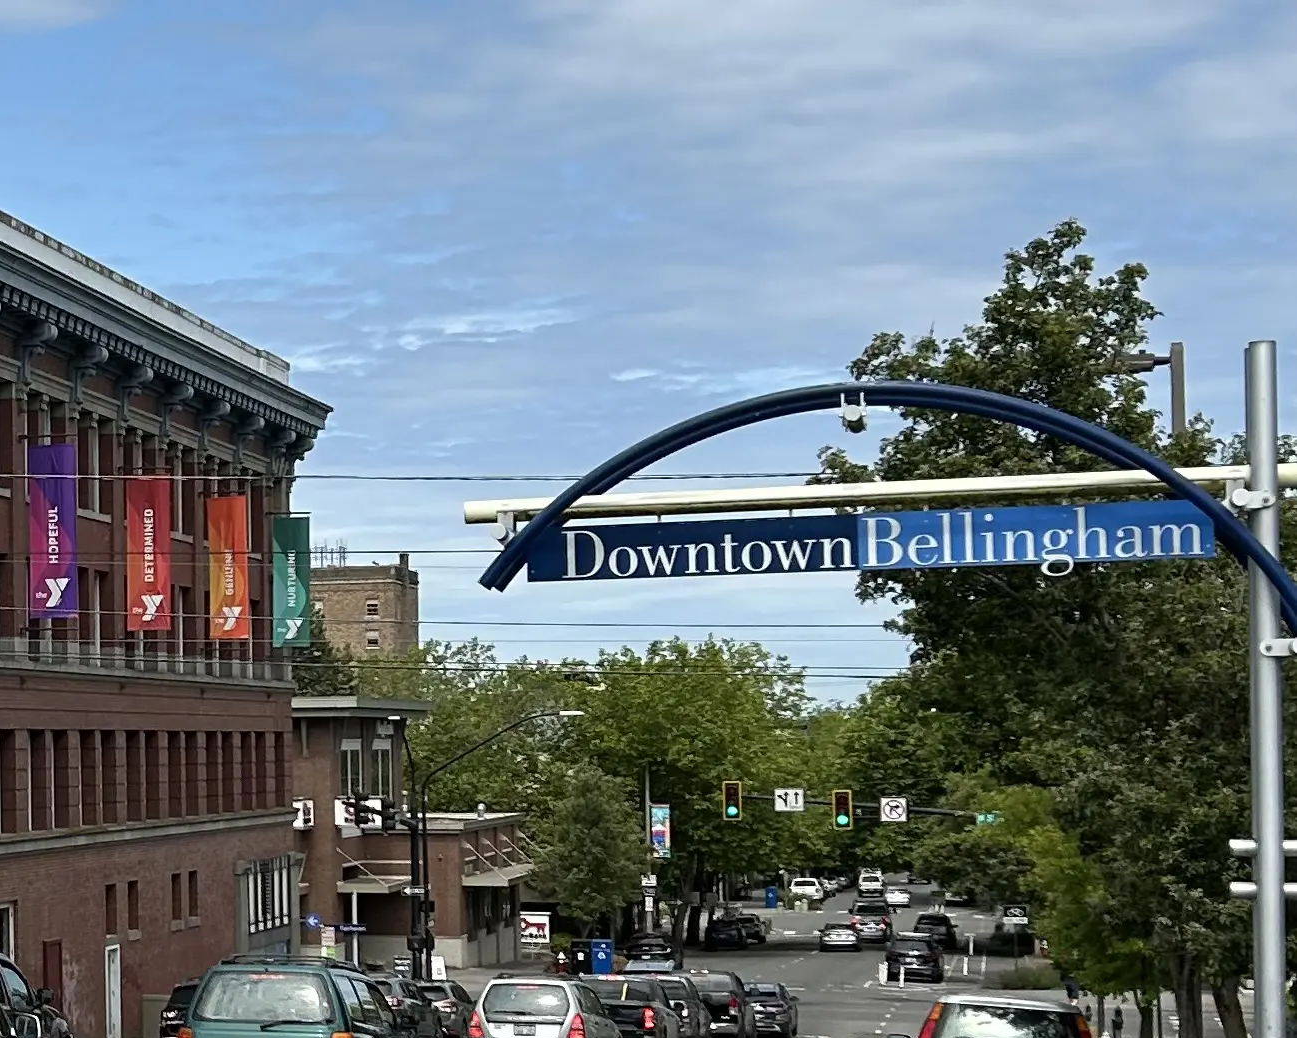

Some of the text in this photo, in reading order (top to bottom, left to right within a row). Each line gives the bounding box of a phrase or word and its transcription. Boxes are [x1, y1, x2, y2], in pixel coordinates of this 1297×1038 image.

[48, 505, 59, 564] HOPEFUL
[143, 508, 155, 583] DETERMINED
[561, 506, 1206, 579] Downtown Bellingham
